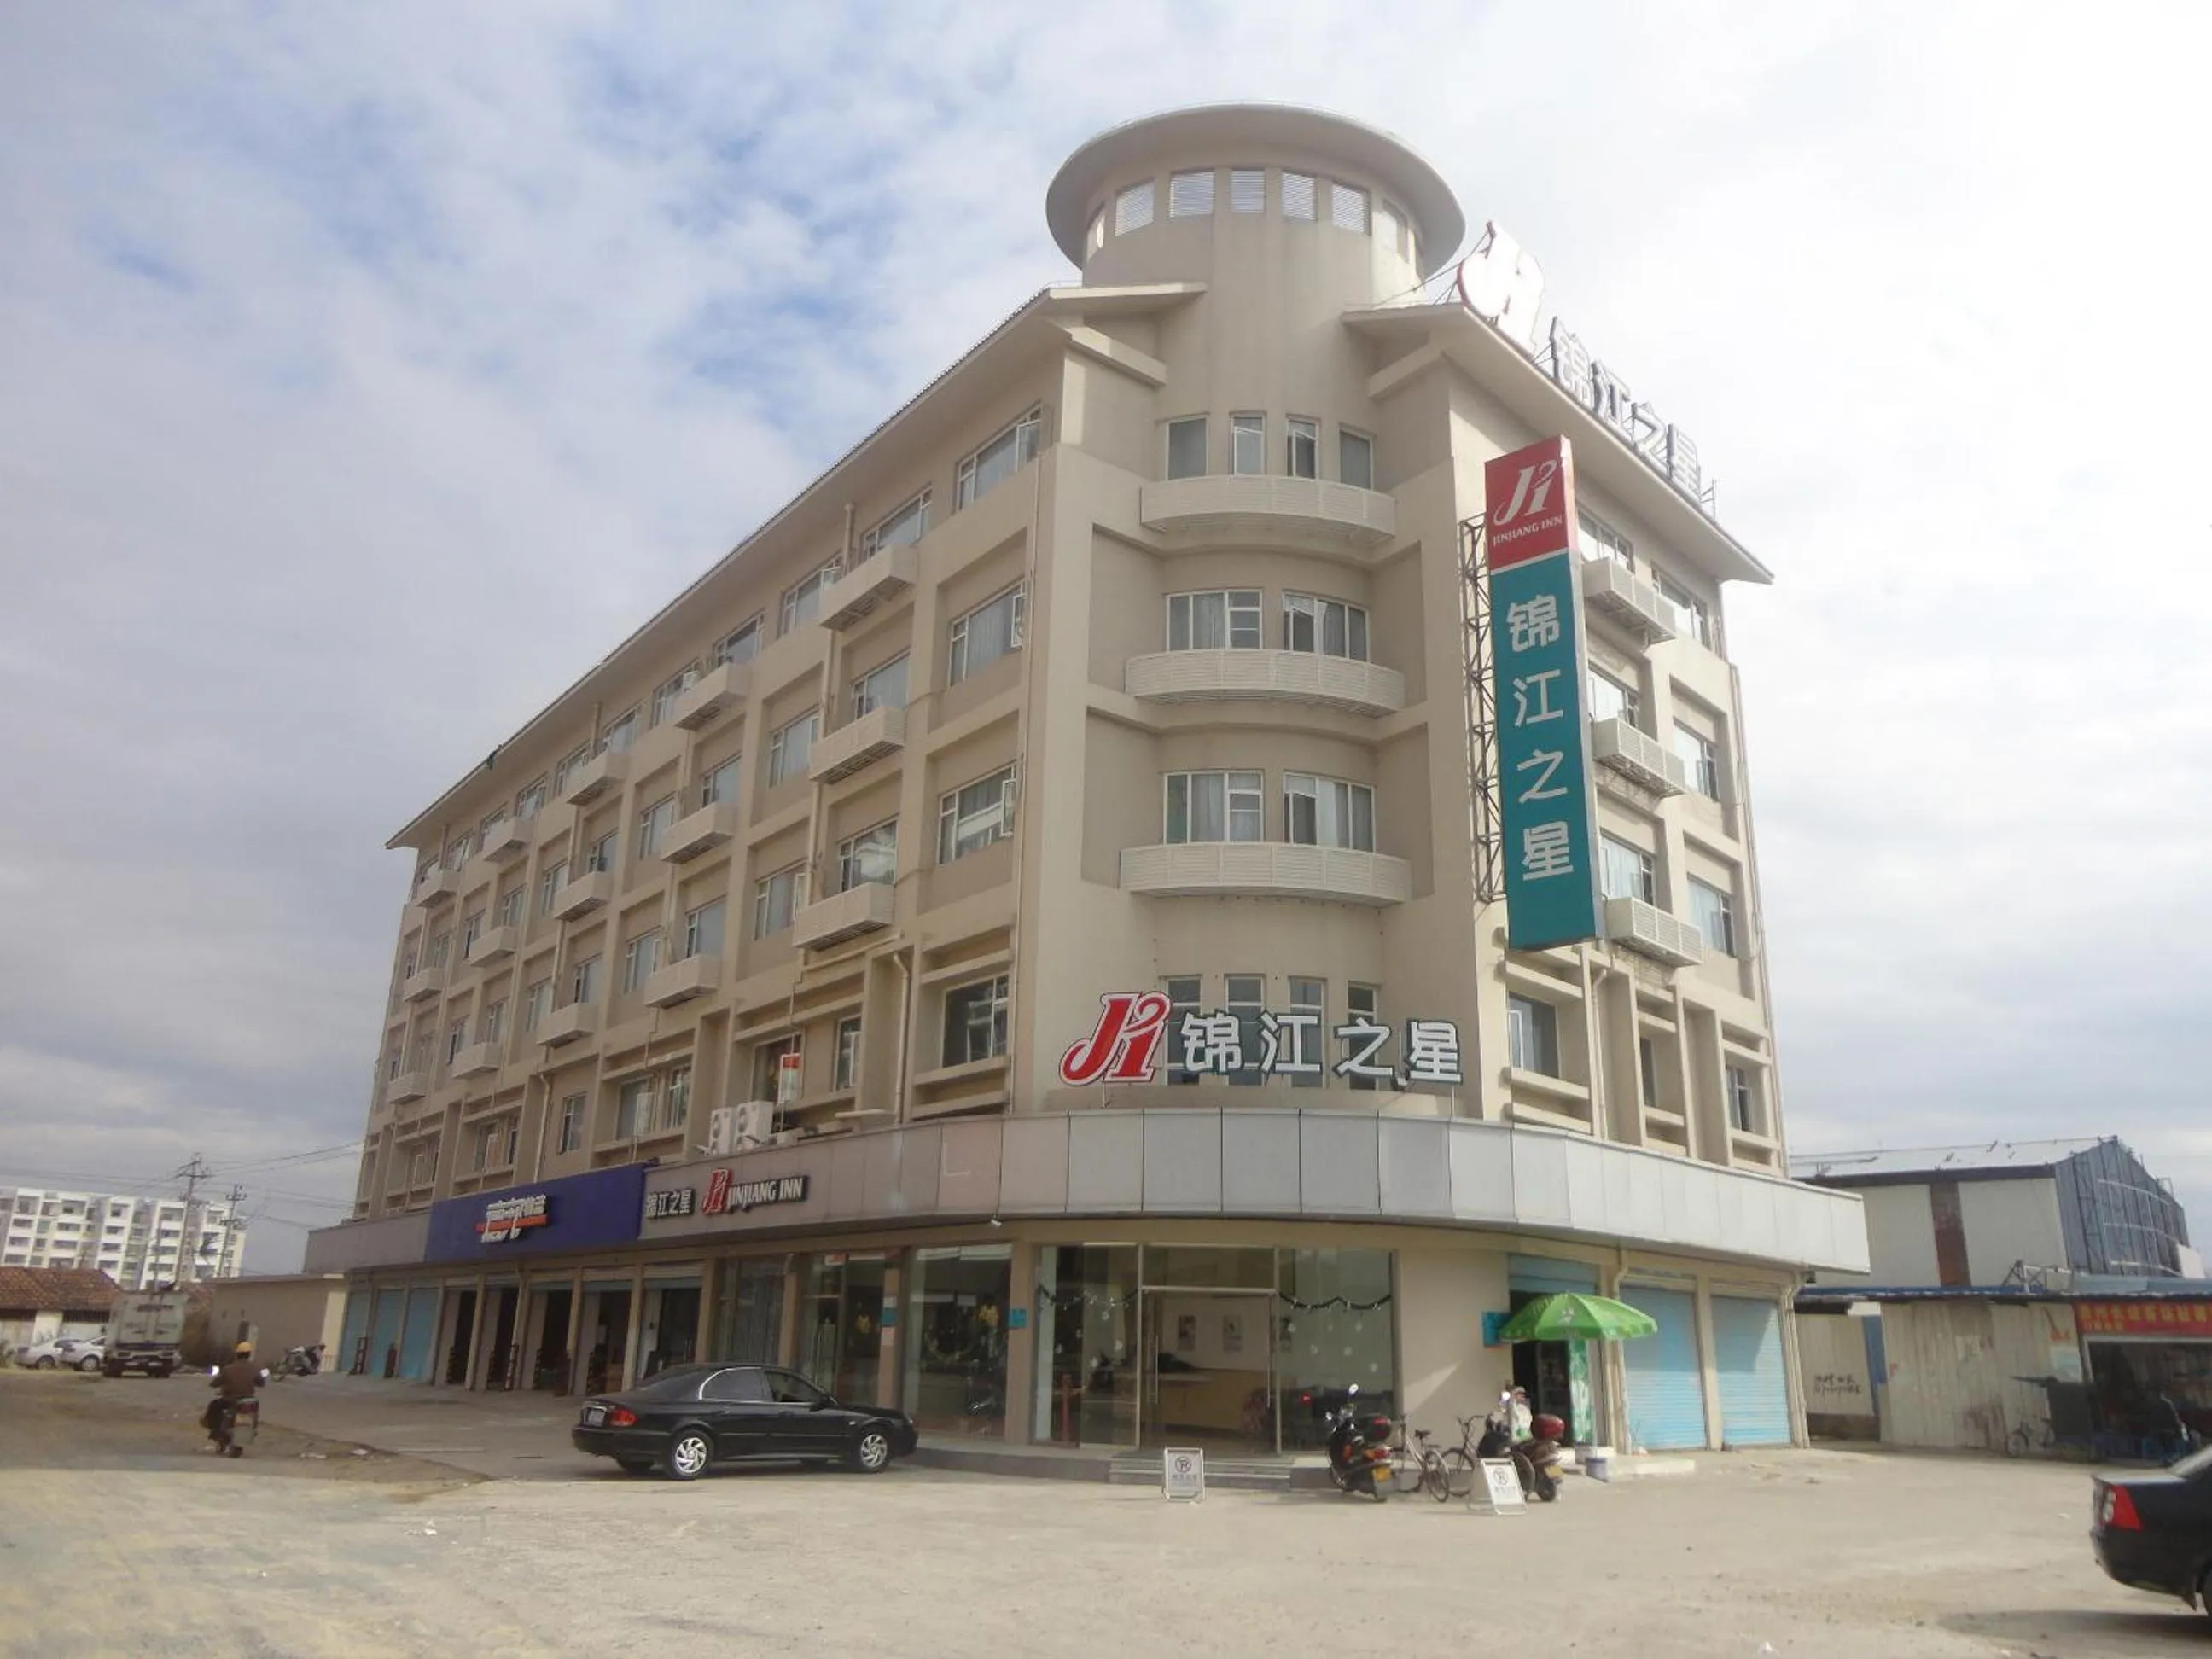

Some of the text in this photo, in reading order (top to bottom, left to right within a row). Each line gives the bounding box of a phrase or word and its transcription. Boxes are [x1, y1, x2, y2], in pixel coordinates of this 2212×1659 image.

[1493, 515, 1563, 548] JINJIANG INN
[1505, 593, 1575, 882] 锦江之星
[1180, 1009, 1463, 1085] 锦江之星
[646, 1188, 693, 1219] 锦江之星
[727, 1180, 777, 1210] JINJIANG
[778, 1177, 804, 1200] INN
